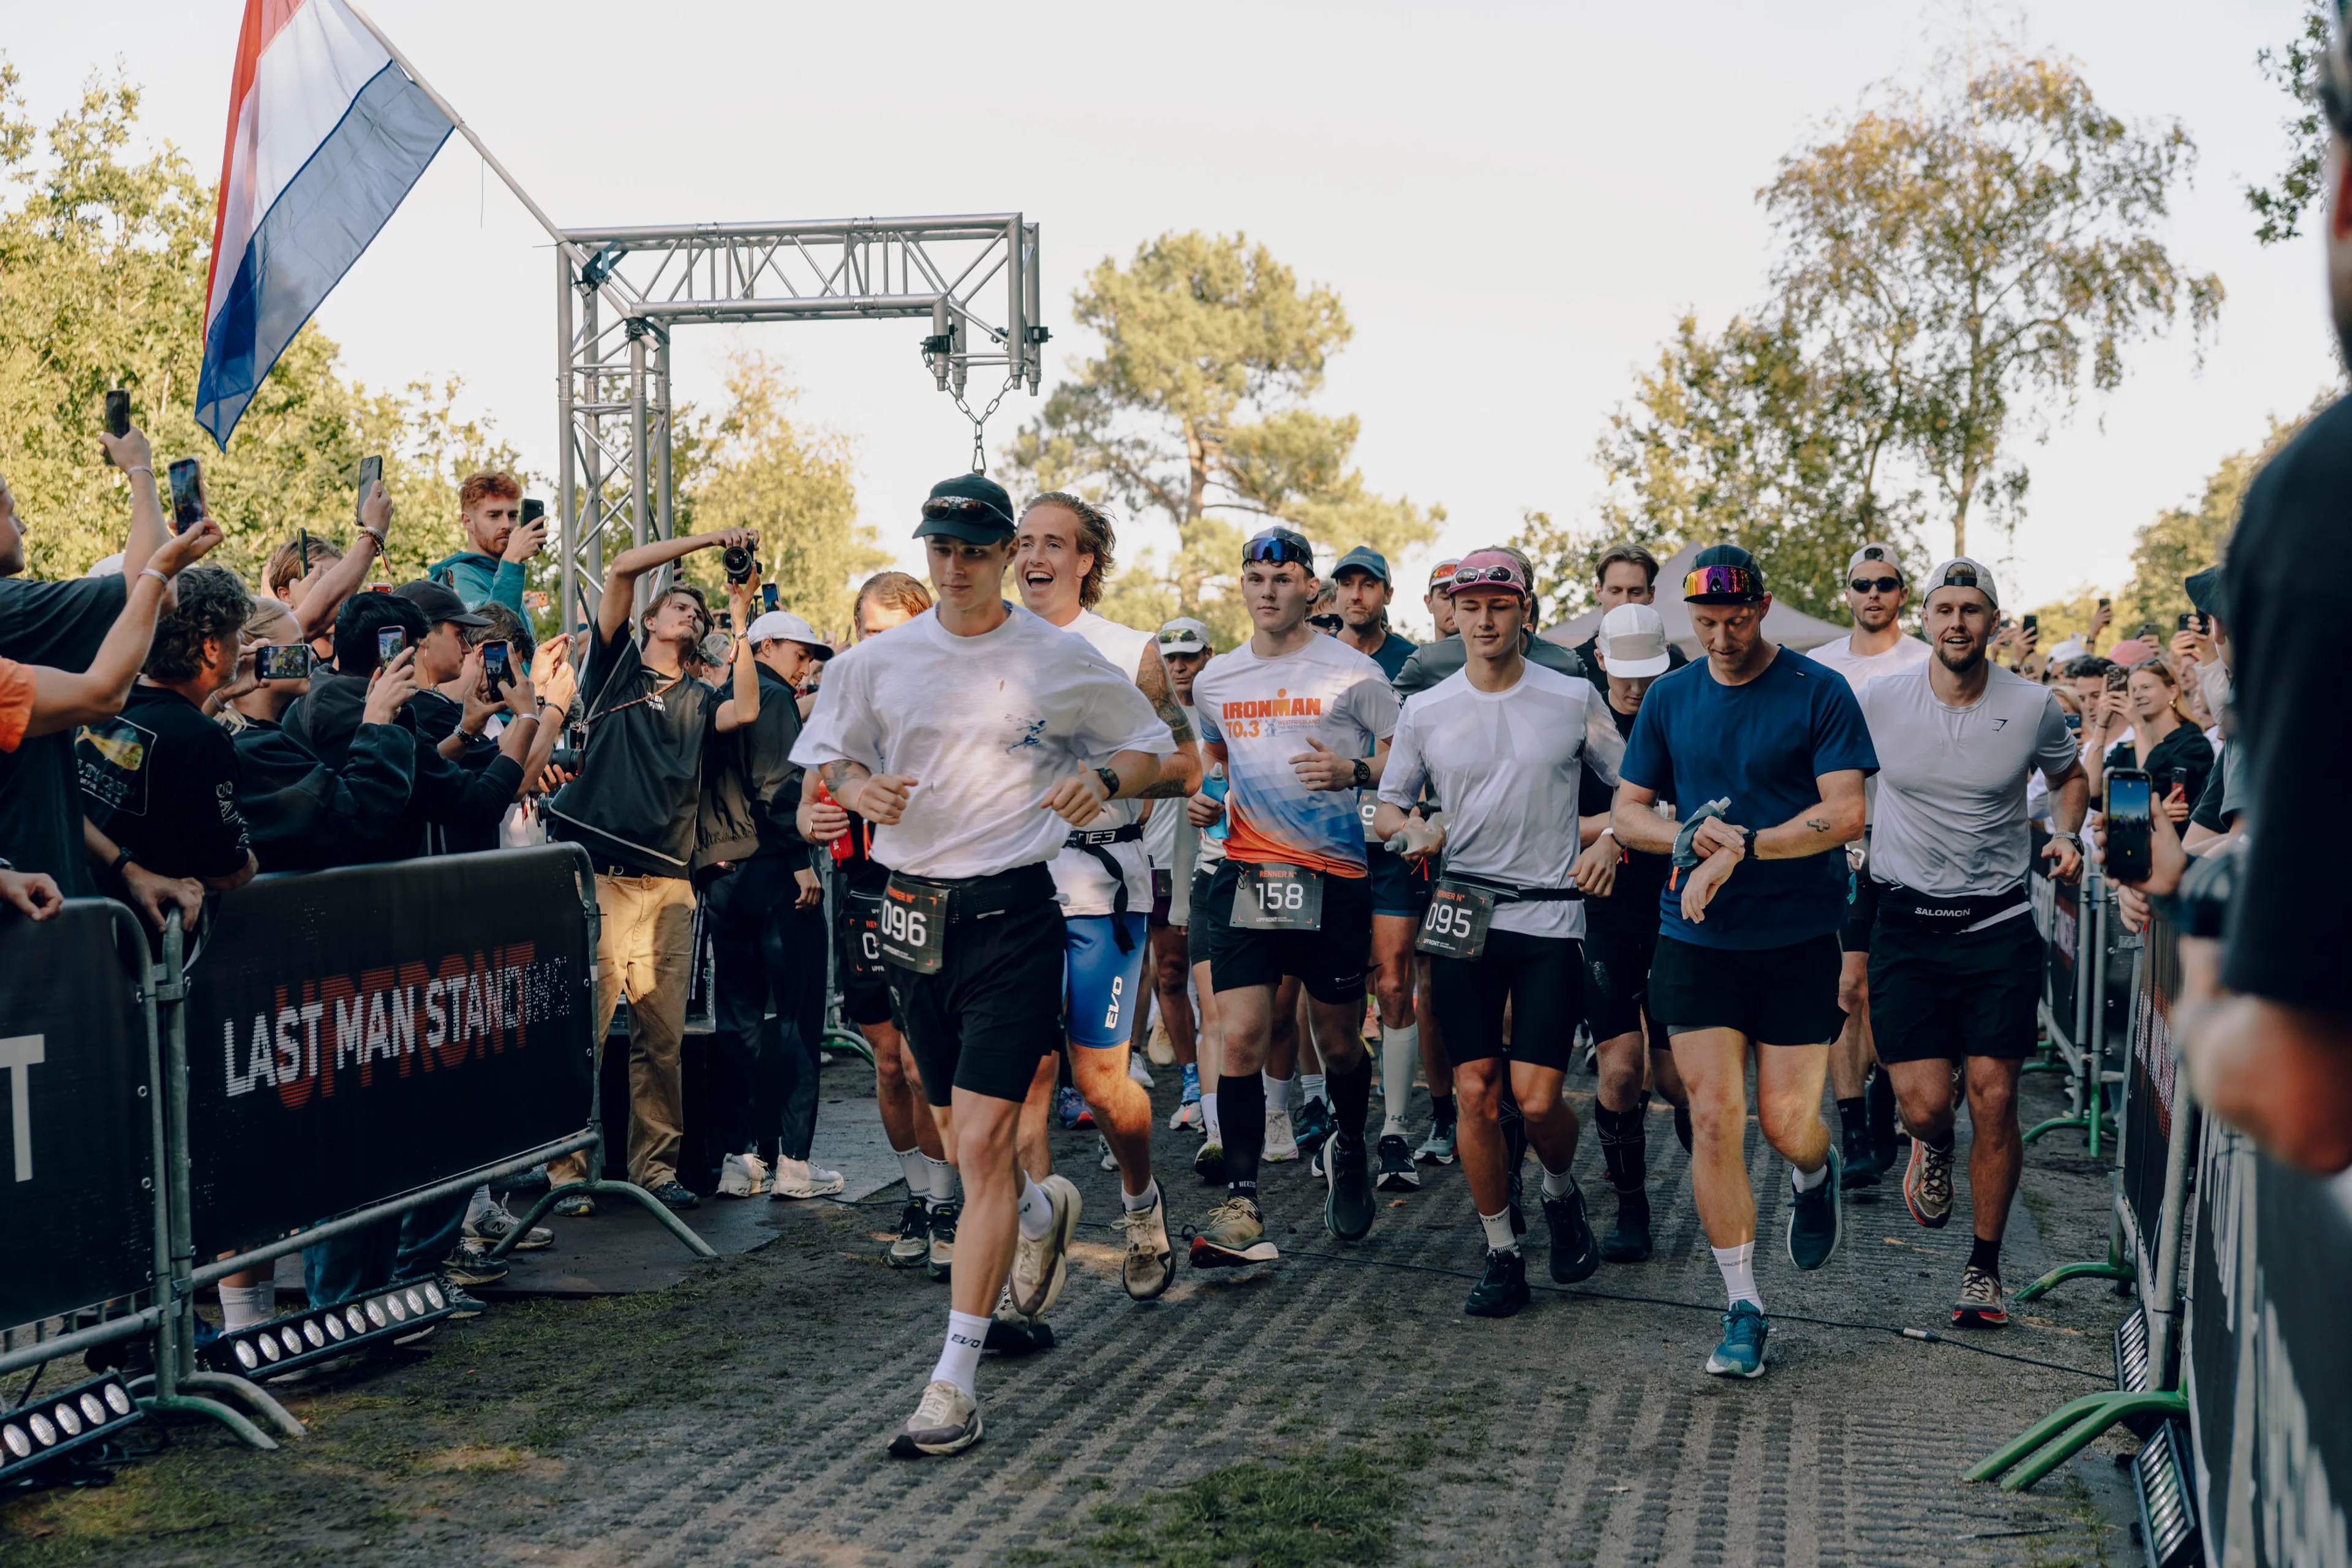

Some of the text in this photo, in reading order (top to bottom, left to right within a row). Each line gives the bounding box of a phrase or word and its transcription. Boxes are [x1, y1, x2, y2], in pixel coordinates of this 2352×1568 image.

[1223, 688, 1321, 720] IRONMAN
[1226, 720, 1260, 738] 70.3
[1256, 883, 1303, 910] 158
[1915, 907, 1970, 917] SALOMON
[881, 899, 927, 947] 096
[1425, 902, 1472, 938] 095
[1104, 976, 1123, 1029] EVO
[224, 956, 571, 1097] LAST MAN STANDING
[951, 1333, 981, 1348] EVO
